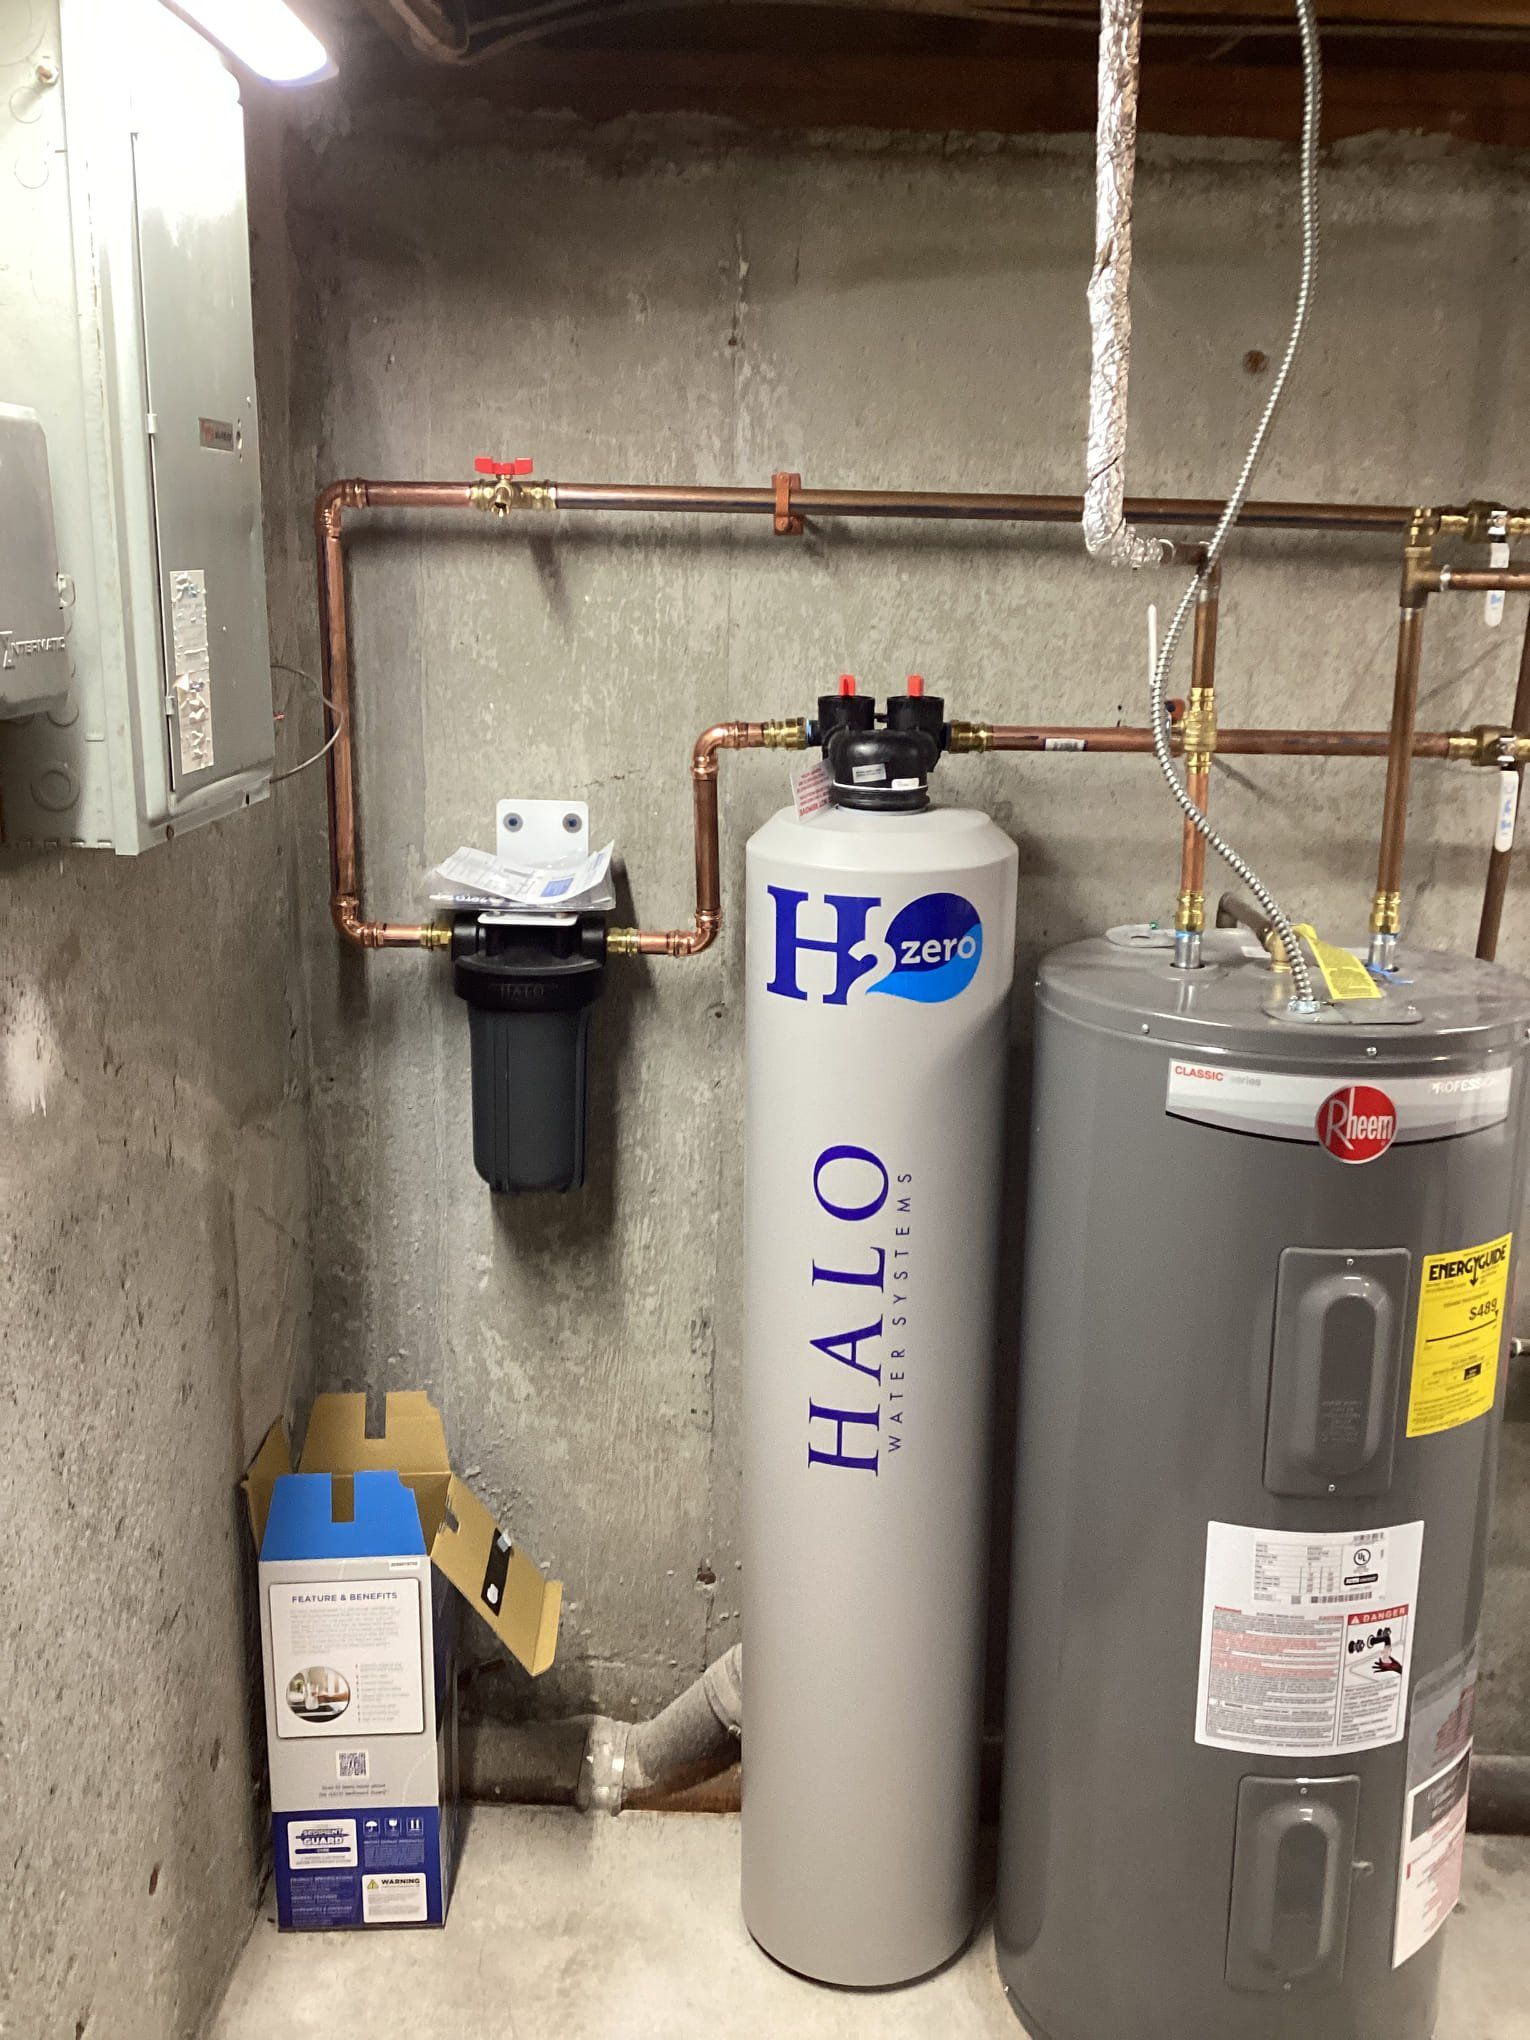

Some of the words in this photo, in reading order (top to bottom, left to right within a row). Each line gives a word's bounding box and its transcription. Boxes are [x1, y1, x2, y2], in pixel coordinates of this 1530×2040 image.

[901, 935, 976, 965] zero
[1175, 1065, 1224, 1081] CLASSIC
[1325, 1087, 1393, 1150] Rheem
[893, 1172, 913, 1326] SYSTEMS
[806, 1145, 889, 1476] HALO
[888, 1348, 906, 1453] WATER
[292, 1594, 338, 1603] FEATURE
[349, 1591, 398, 1601] BENEFITS
[1363, 1606, 1406, 1623] DANGER
[303, 1836, 343, 1845] GUARD
